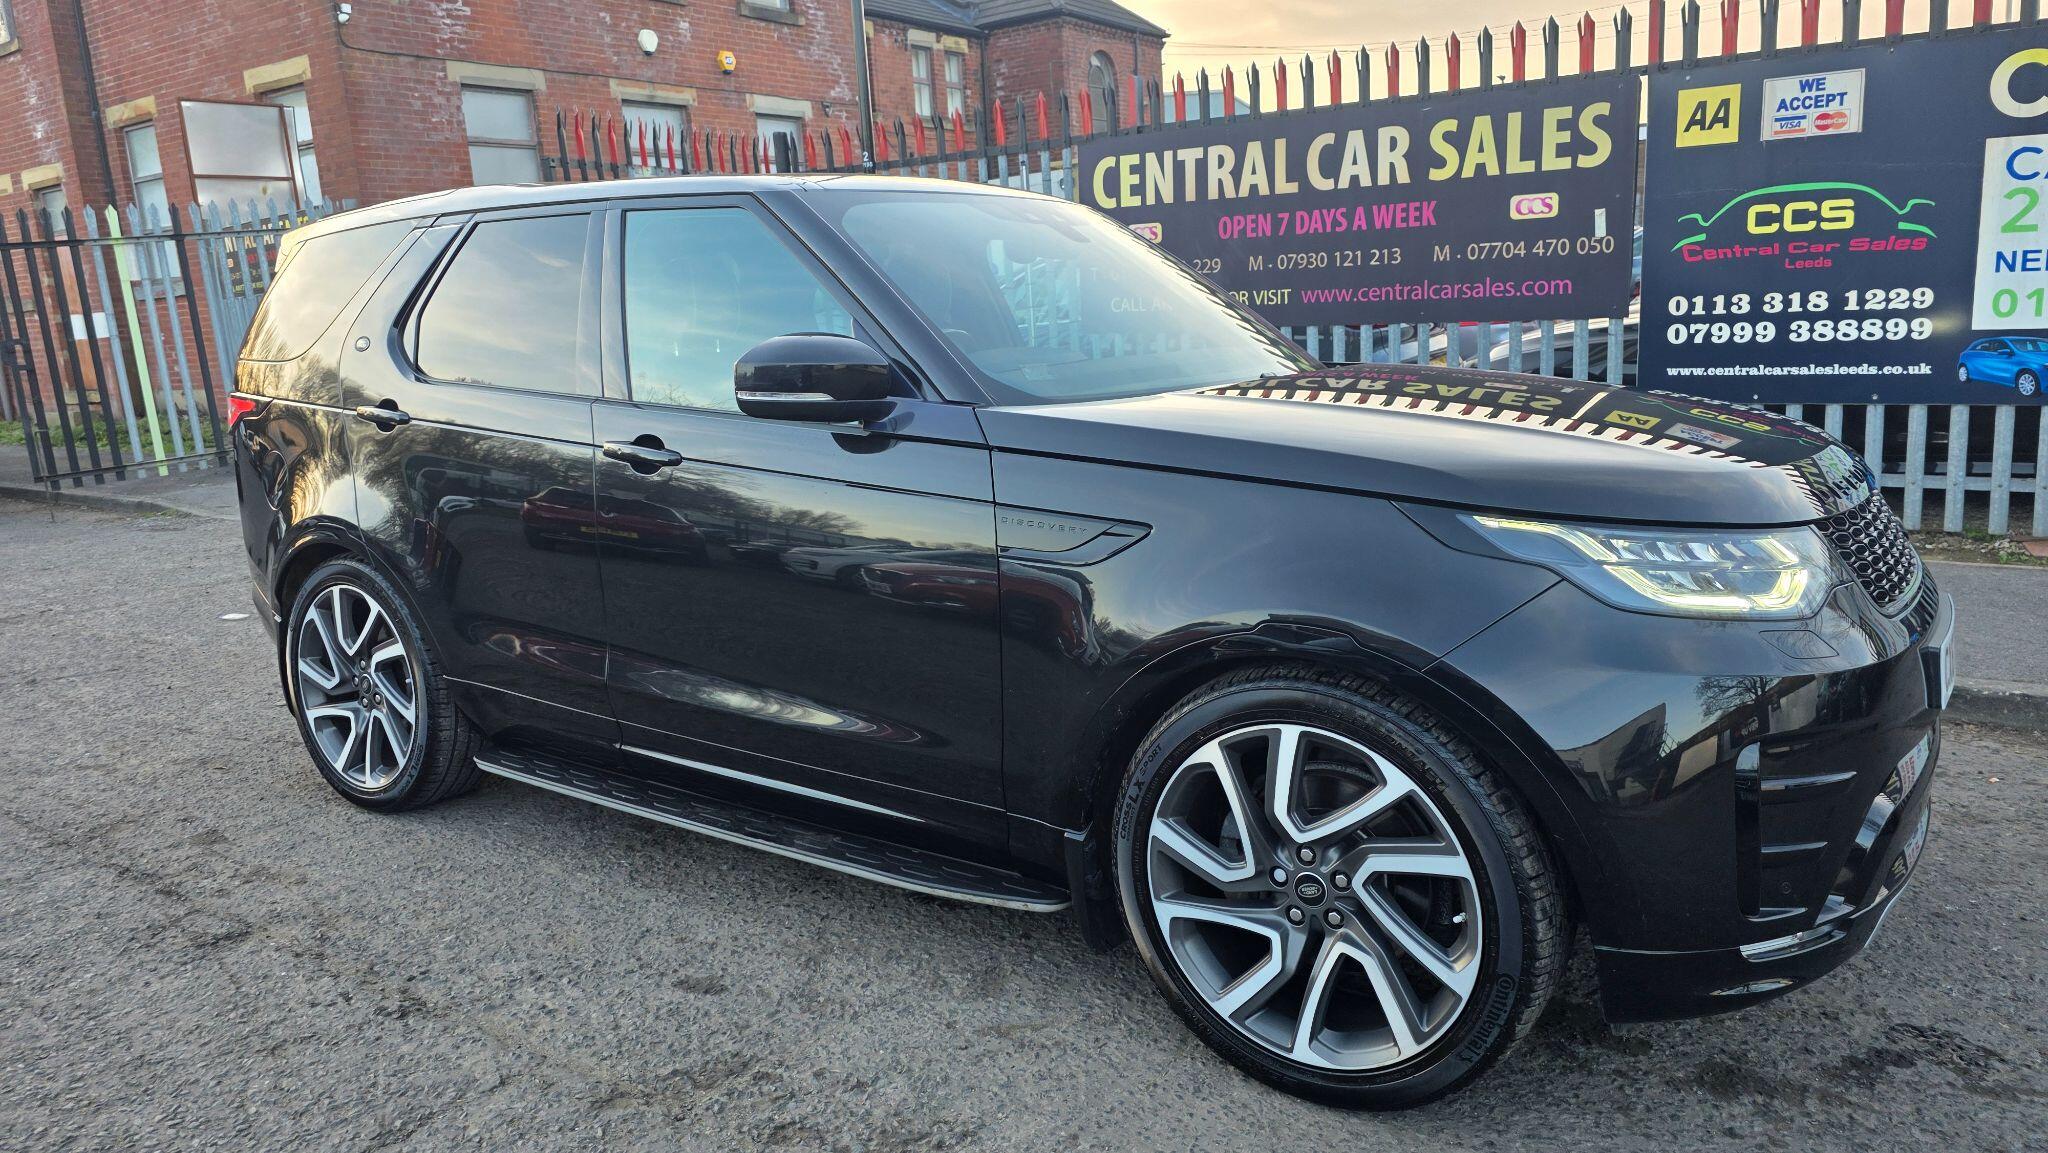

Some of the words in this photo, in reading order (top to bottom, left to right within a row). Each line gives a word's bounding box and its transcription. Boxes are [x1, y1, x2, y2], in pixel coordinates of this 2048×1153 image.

[1799, 77, 1826, 93] WE
[1683, 98, 1731, 133] AA
[1776, 92, 1848, 113] ACCEPT
[1780, 121, 1801, 129] VISA
[862, 151, 869, 162] 2
[1093, 137, 1298, 209] CENTRAL
[1306, 125, 1410, 191] CAR
[1428, 101, 1612, 182] SALES
[1515, 196, 1554, 216] CCS
[1747, 198, 1855, 234] CCS
[1218, 214, 1272, 240] OPEN
[1277, 213, 1290, 237] 7
[1294, 208, 1347, 235] DAYS
[1352, 207, 1367, 231] A
[1371, 200, 1437, 229] WEEK
[1277, 252, 1328, 270] 07930
[1334, 250, 1361, 267] 121
[1370, 247, 1402, 265] 213
[1467, 241, 1526, 260] 07704
[1532, 238, 1570, 257] 470
[1576, 235, 1615, 255] 050
[1682, 242, 1780, 262] Central
[1788, 241, 1840, 254] Car
[1849, 235, 1928, 252] Sales
[1785, 256, 1833, 269] Leeds
[1253, 288, 1292, 306] VISIT
[1301, 276, 1572, 304] www.centralcarsales.com
[1668, 293, 1751, 316] 0113
[1762, 290, 1829, 314] 318
[1843, 287, 1934, 311] 1229
[1111, 298, 1147, 313] CALL
[1666, 321, 1776, 345] 07999
[1788, 317, 1934, 343] 388899
[1666, 363, 1932, 377] www.centralcarsalesleeds.co.uk
[1001, 516, 1088, 535] DISCOVERY
[1120, 801, 1132, 840] CROSS
[1128, 778, 1145, 804] LX
[1139, 744, 1162, 777] SPORT
